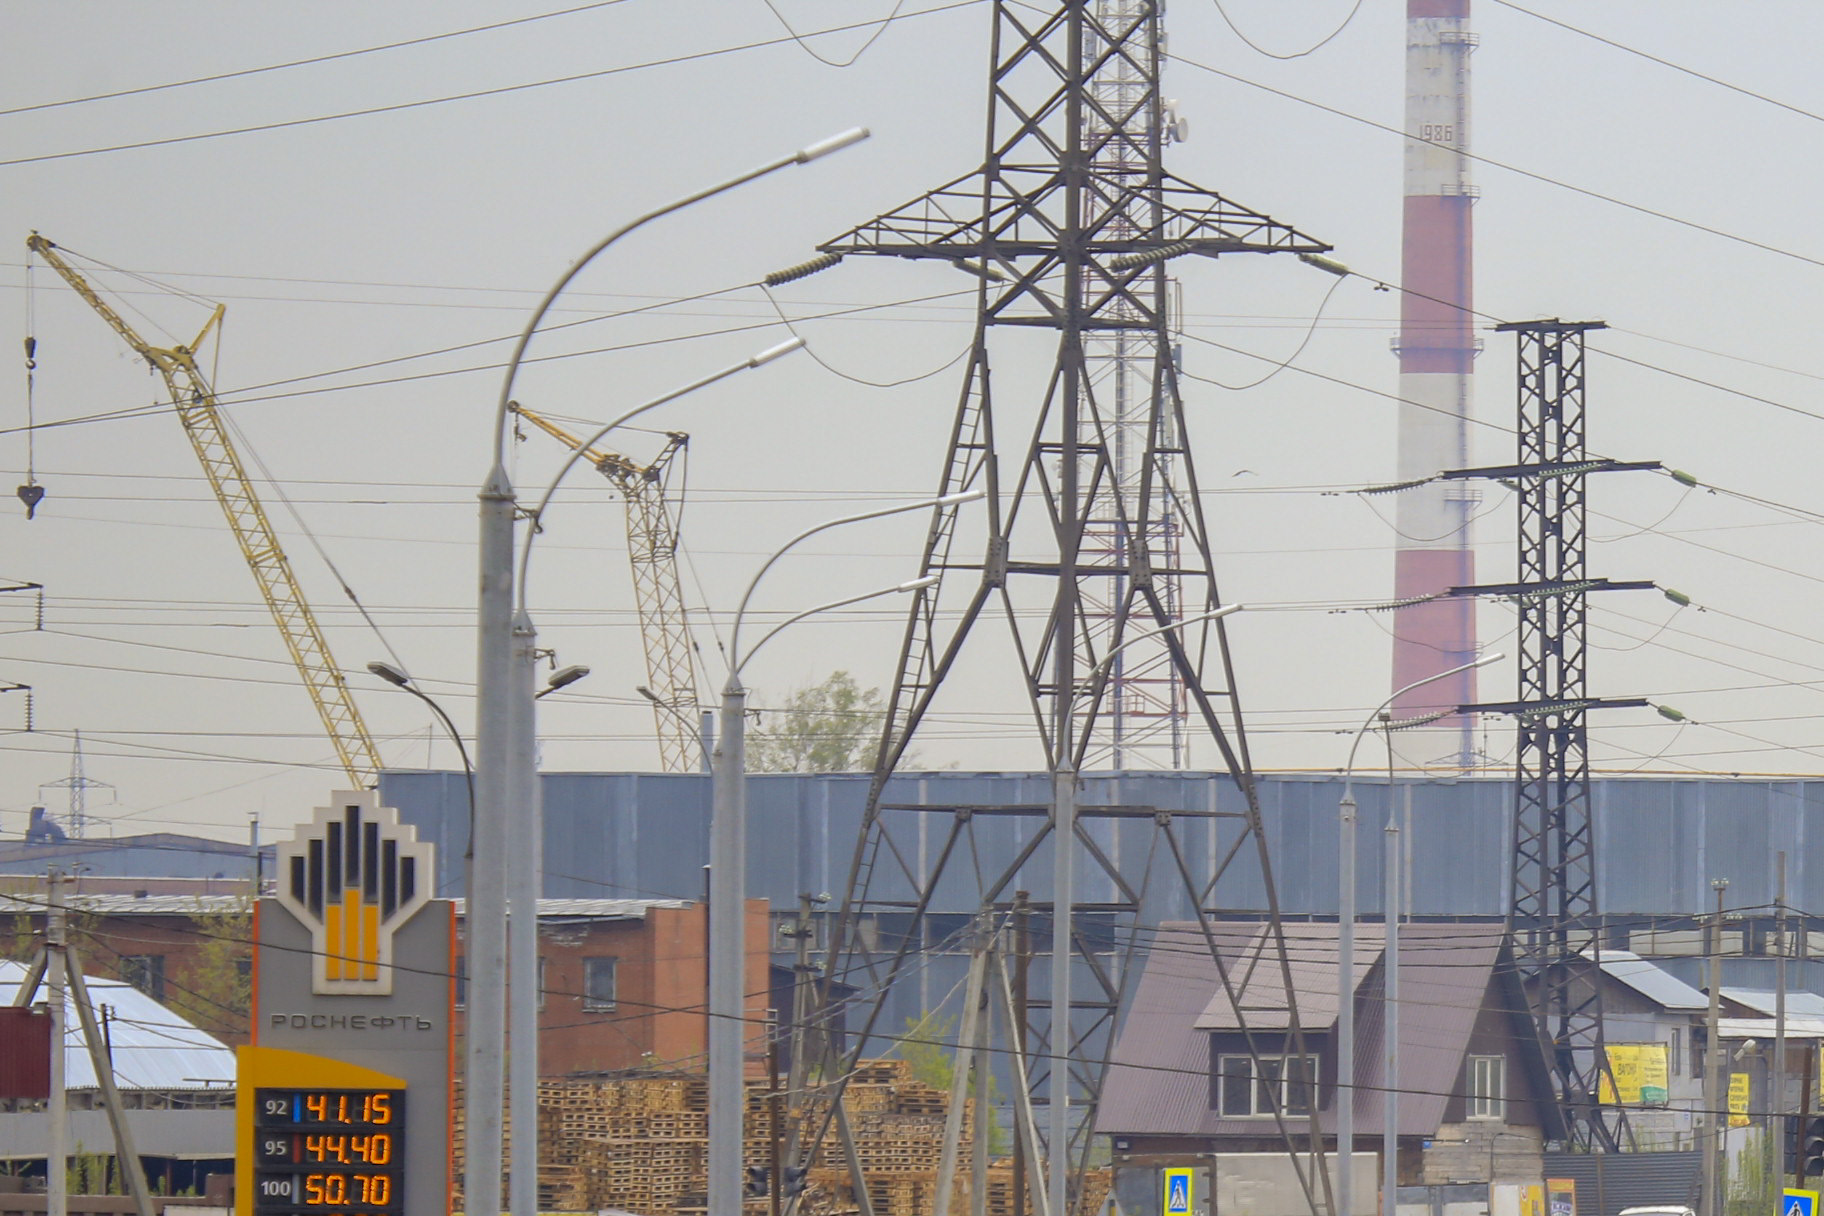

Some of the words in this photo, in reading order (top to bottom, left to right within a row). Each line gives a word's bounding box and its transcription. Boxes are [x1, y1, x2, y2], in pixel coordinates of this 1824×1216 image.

[271, 1013, 432, 1031] РОСНЕФТЬ
[265, 1100, 287, 1115] 92
[306, 1094, 391, 1125] 41.15
[265, 1141, 286, 1155] 95
[306, 1134, 391, 1165] 44.40
[261, 1180, 291, 1196] 100
[305, 1174, 391, 1205] 50.70
